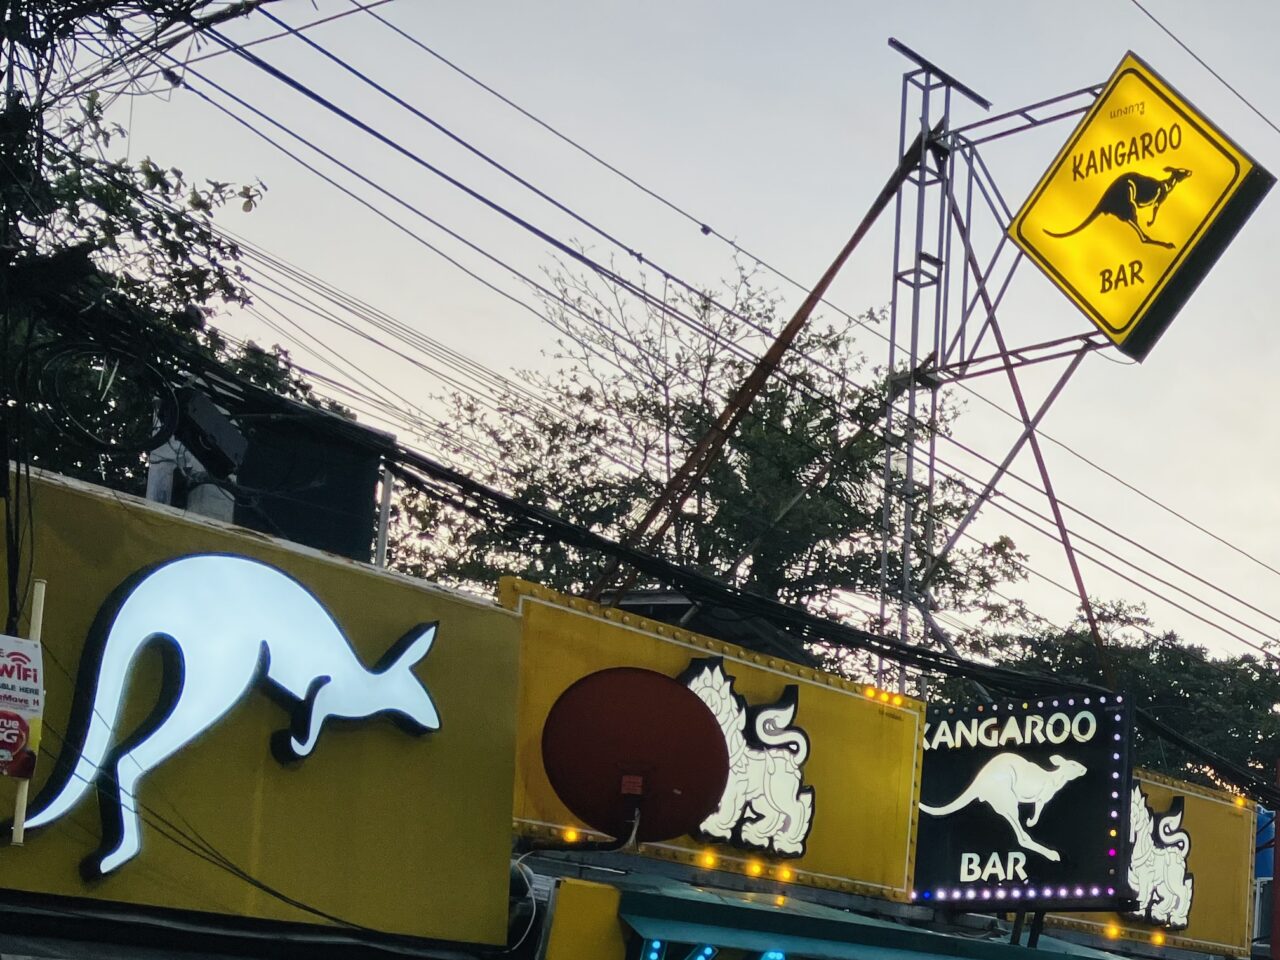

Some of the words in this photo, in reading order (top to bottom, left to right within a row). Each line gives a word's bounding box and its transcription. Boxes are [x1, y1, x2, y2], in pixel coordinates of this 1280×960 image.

[1072, 123, 1182, 182] KANGAROO
[1099, 260, 1145, 294] BAR
[959, 851, 1028, 883] BAR
